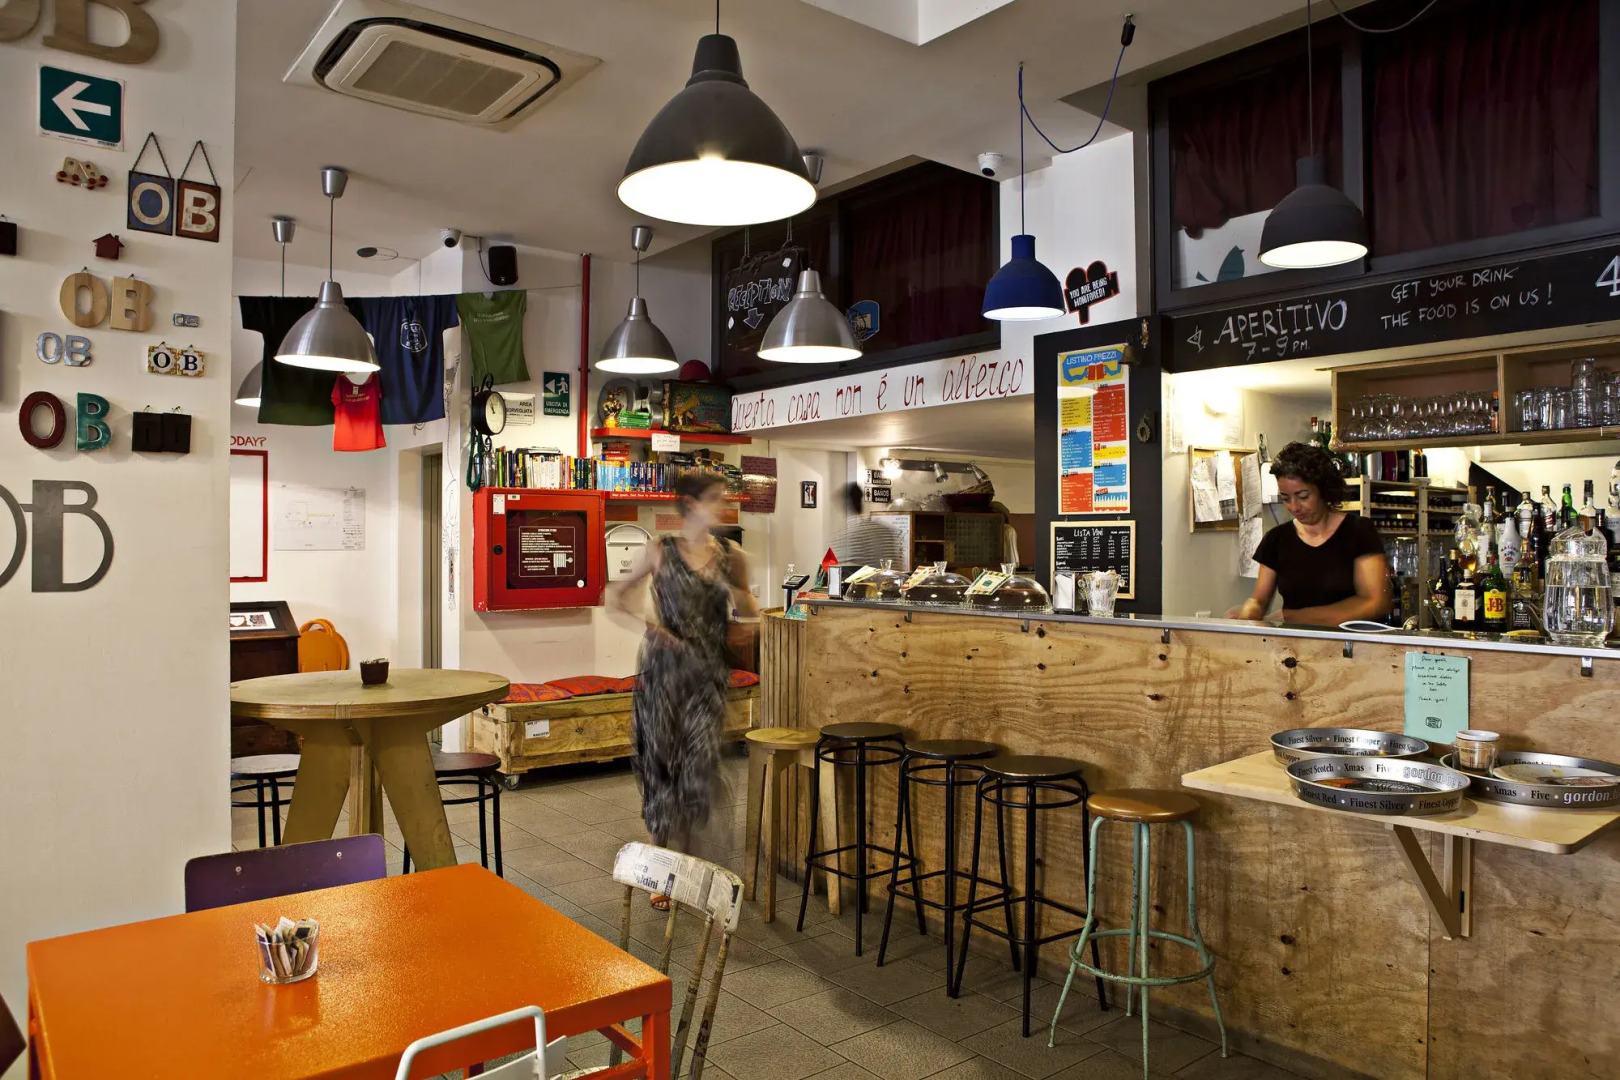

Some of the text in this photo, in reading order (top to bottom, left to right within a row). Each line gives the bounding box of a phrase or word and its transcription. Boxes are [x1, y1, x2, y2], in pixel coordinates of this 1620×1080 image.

[1070, 277, 1108, 299] YOU ARE BEING
[1391, 266, 1520, 303] GET YOUR DRINK
[1213, 299, 1348, 344] APERITIVO
[1381, 310, 1411, 330] THE
[1418, 304, 1456, 322] FOOD
[1466, 300, 1480, 316] IS
[1490, 294, 1510, 310] ON
[1066, 350, 1117, 365] LISTINO PREZZI
[731, 392, 775, 432] Questa
[788, 392, 820, 424] casa
[836, 385, 862, 416] non
[904, 374, 926, 406] un
[1074, 529, 1090, 537] LISTA
[1313, 764, 1334, 773] Scotch
[1303, 788, 1320, 800] Finest
[1323, 793, 1336, 804] Red
[1351, 798, 1377, 808] Finest
[1379, 799, 1405, 810] Silver
[1494, 785, 1517, 796] Xmas
[1531, 790, 1550, 800] Five
